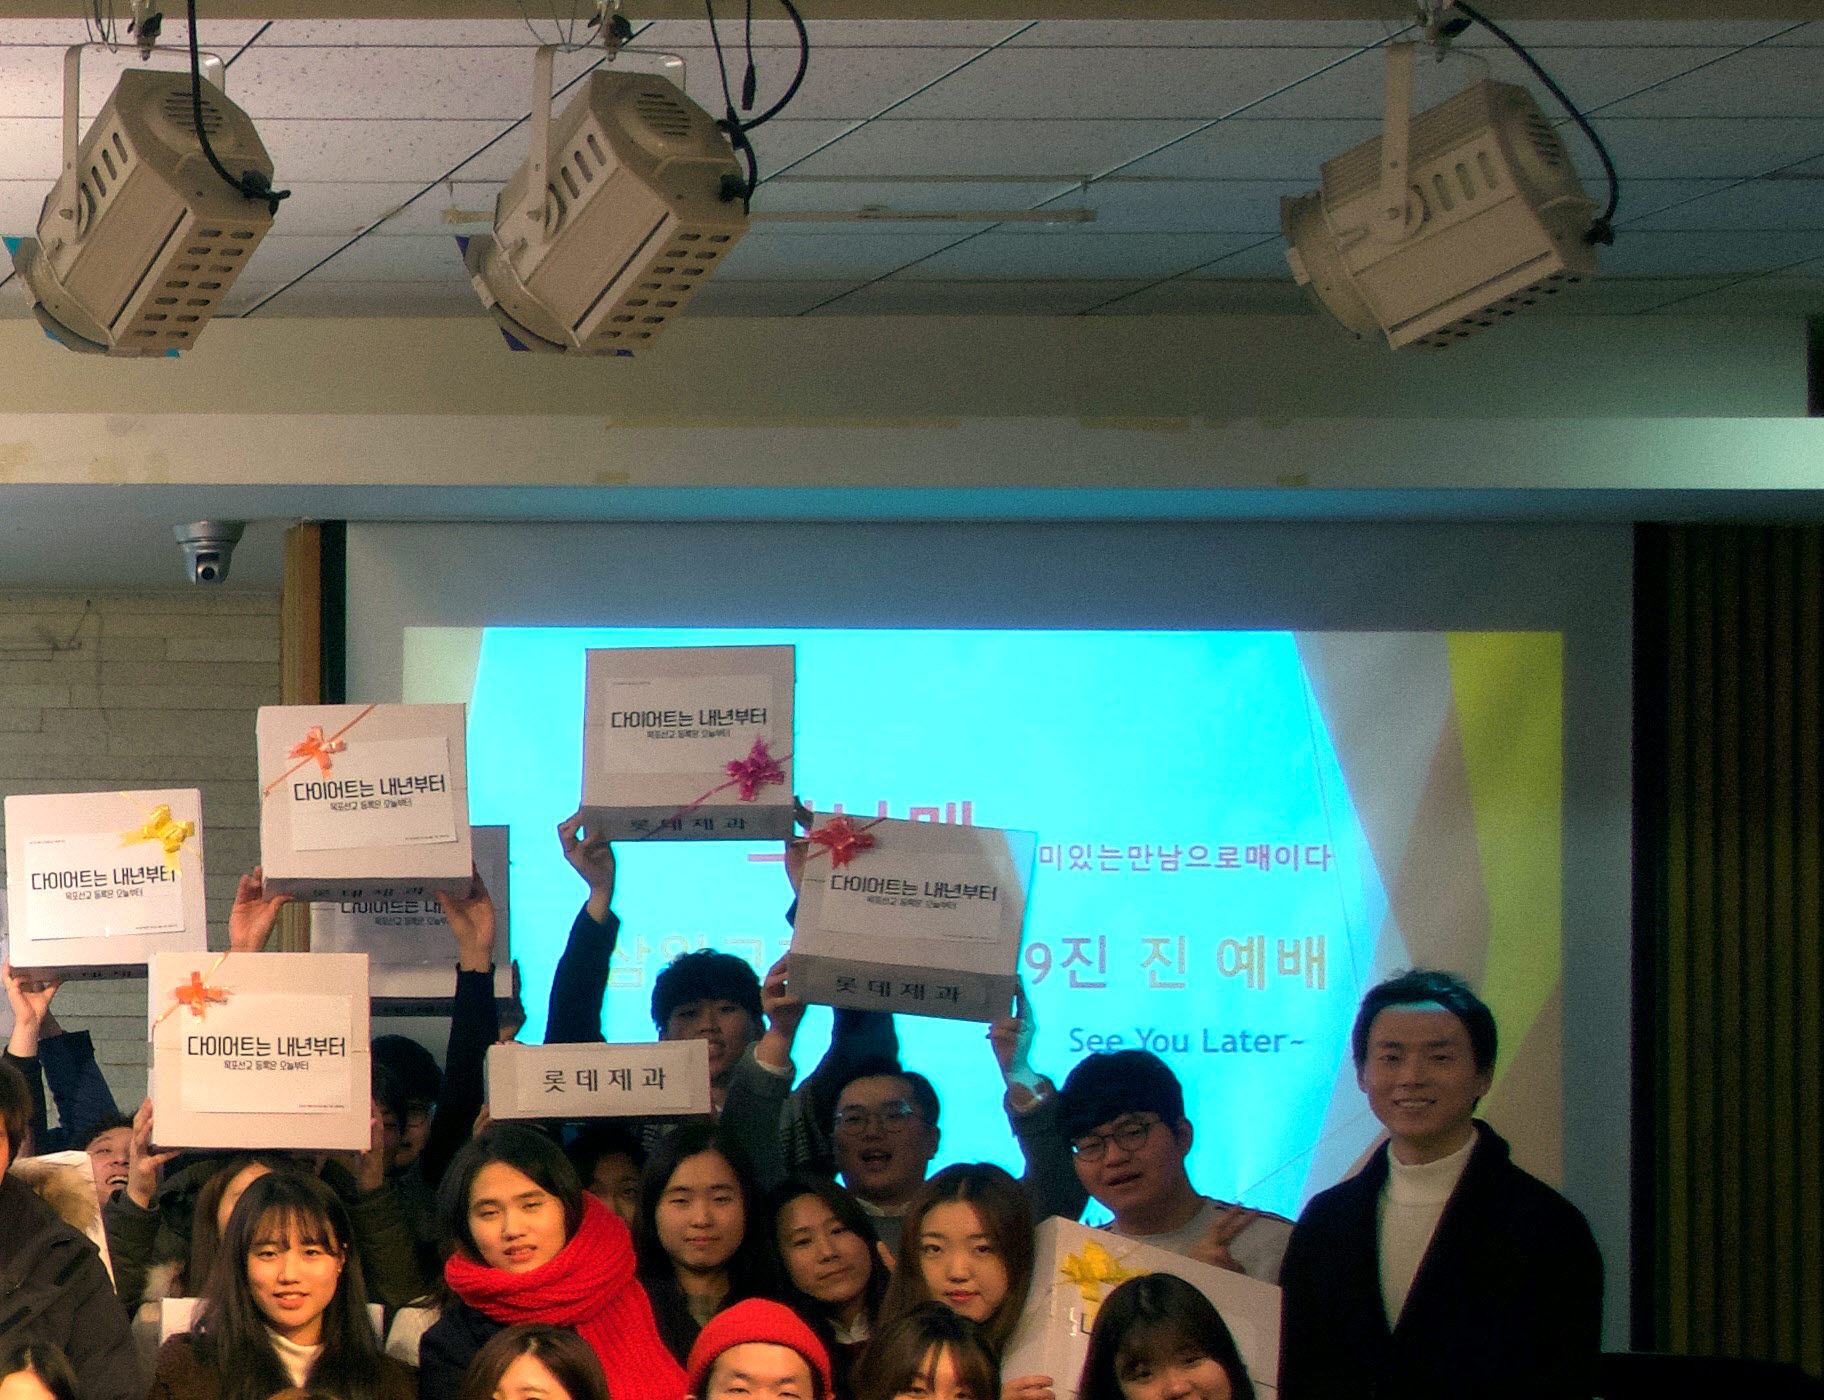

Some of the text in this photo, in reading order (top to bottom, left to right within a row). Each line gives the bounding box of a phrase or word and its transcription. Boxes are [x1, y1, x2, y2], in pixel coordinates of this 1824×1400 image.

[612, 708, 767, 728] 다이어트는 내년부터
[294, 775, 446, 801] 다이어트는 내년부터
[32, 871, 108, 890] 다이어트는
[831, 875, 998, 902] 다이어트는 내년부터
[1140, 937, 1186, 990] 진
[1218, 937, 1326, 990] 예배
[835, 976, 960, 1003] 롯데제과
[188, 1036, 345, 1057] 다이어트는 내년부터
[1070, 1028, 1123, 1053] See
[1139, 1028, 1189, 1054] You
[224, 1060, 253, 1071] 목포선교
[280, 1060, 309, 1071] 오늘부터
[543, 1068, 666, 1093] 롯데제과
